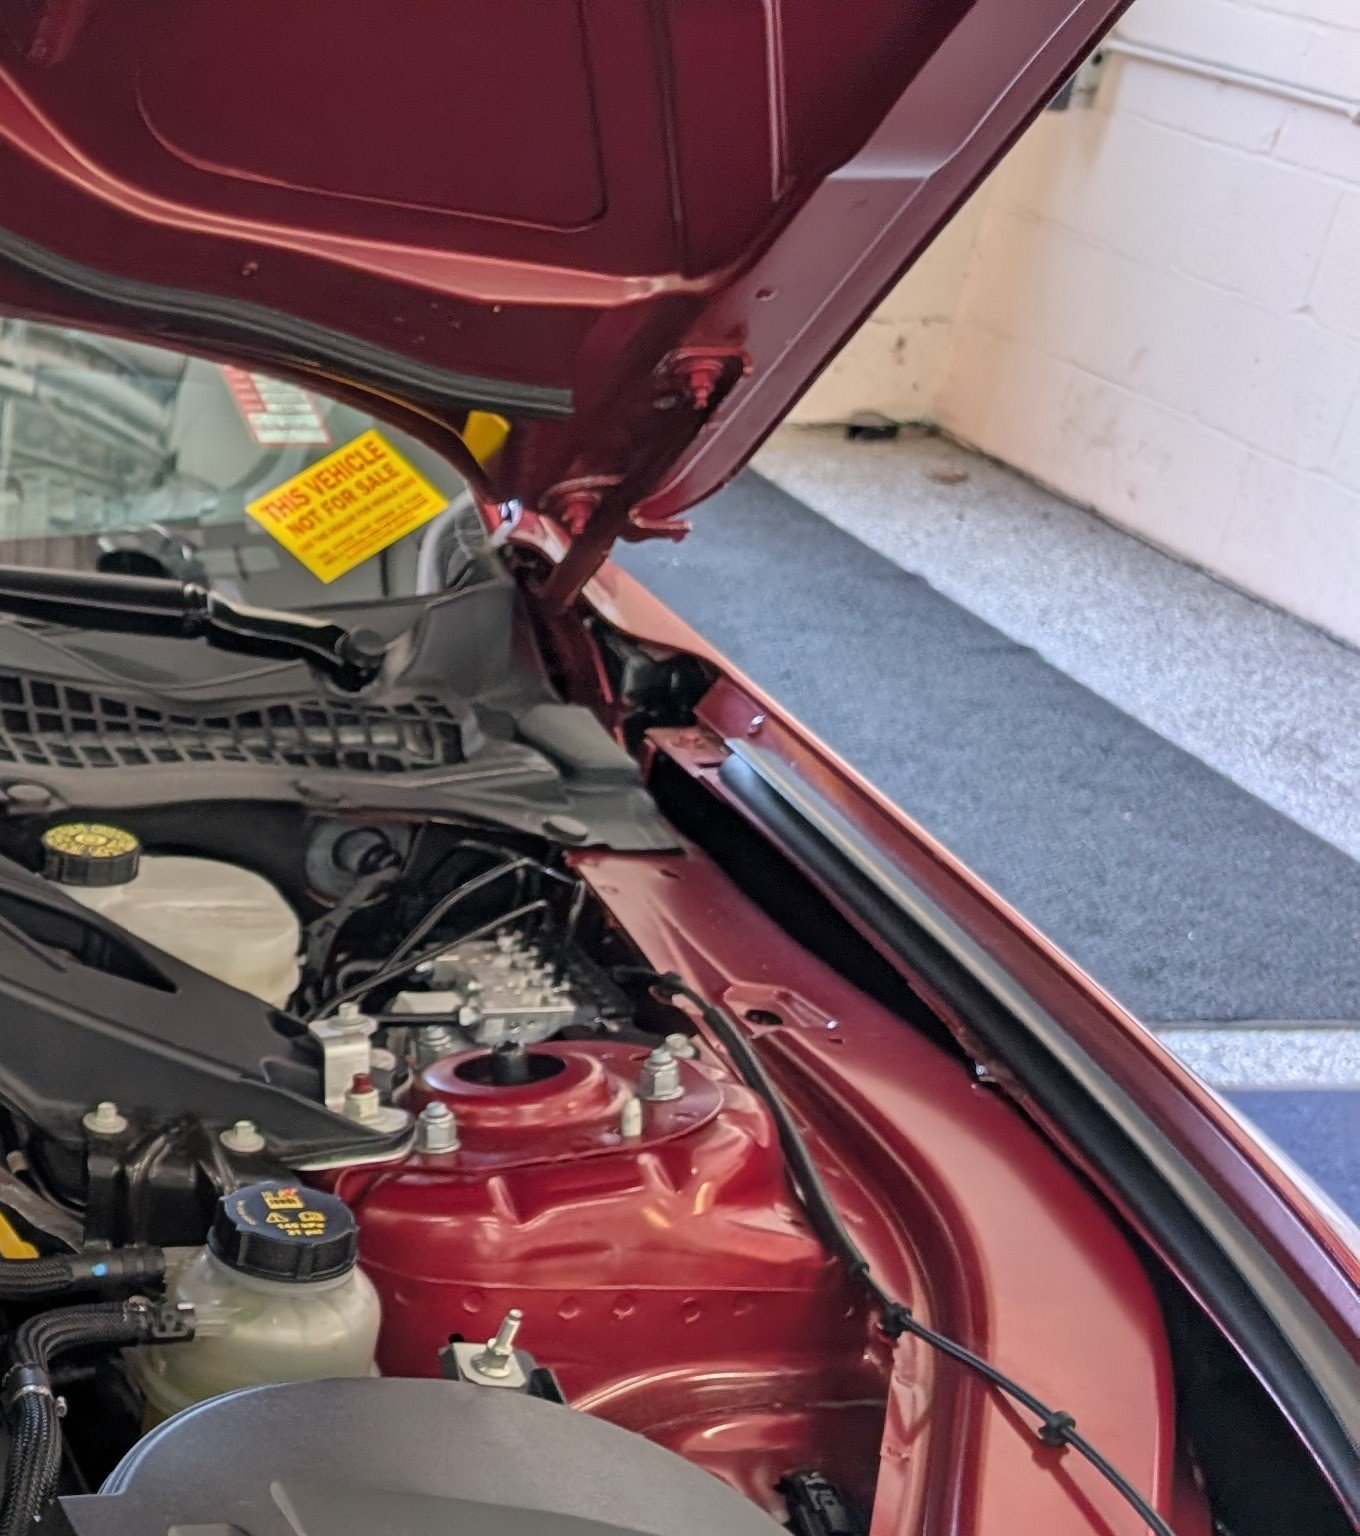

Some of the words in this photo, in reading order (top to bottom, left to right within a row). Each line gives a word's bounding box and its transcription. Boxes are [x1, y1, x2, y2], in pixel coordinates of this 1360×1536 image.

[260, 486, 311, 523] THIS
[304, 439, 386, 495] VEHICLE
[286, 508, 323, 539] NOT
[320, 488, 358, 516] FOR
[354, 461, 400, 495] SALE
